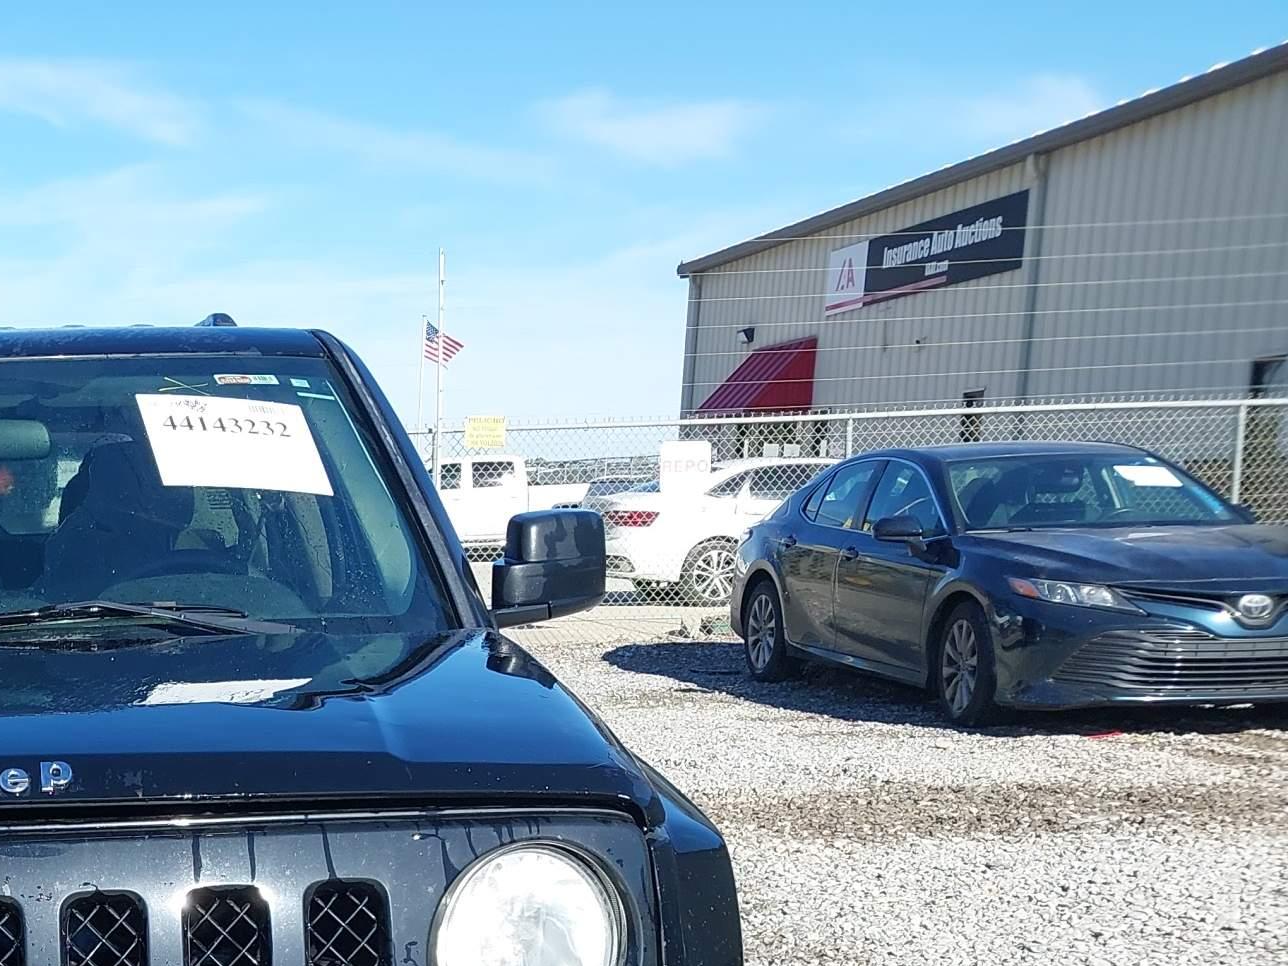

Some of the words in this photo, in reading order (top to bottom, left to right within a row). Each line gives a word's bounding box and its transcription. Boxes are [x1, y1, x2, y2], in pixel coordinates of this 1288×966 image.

[883, 237, 930, 269] Insurance
[931, 229, 954, 256] Auto
[954, 215, 1003, 249] Auctions
[162, 415, 292, 438] 44143232
[662, 460, 709, 473] REPO
